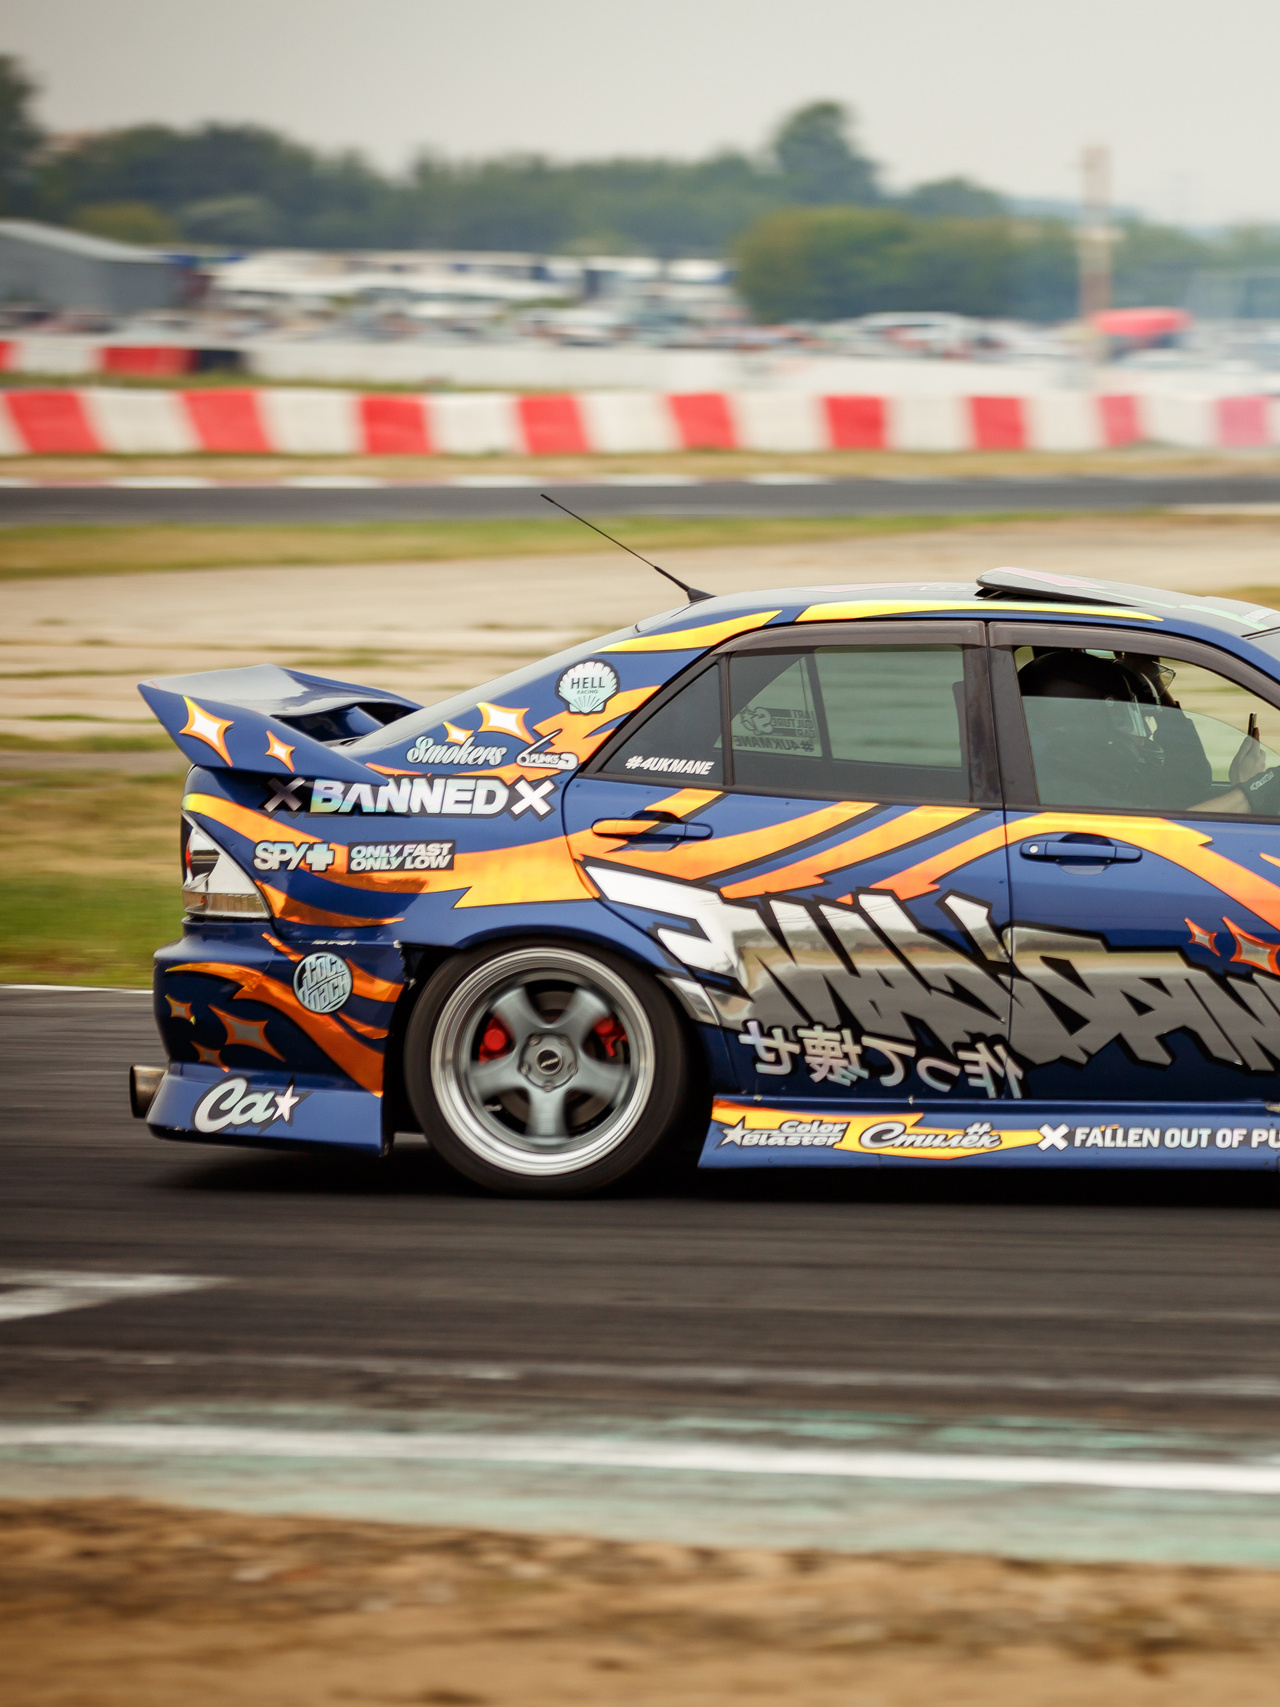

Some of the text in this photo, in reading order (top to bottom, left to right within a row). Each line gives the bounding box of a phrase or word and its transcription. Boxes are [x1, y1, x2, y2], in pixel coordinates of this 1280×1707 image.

[570, 677, 606, 690] HELL
[406, 735, 508, 766] Smokers
[530, 753, 561, 764] PUNKS
[624, 755, 715, 775] #4UKMANE
[310, 777, 510, 815] BANNED
[254, 841, 309, 871] SPY
[350, 842, 453, 859] ONLY FAST
[350, 855, 452, 871] ONLY LOW
[778, 1120, 849, 1135] Color
[741, 1133, 844, 1147] Blaster
[1073, 1126, 1161, 1149] FALLEN
[1164, 1127, 1211, 1149] OUT
[1214, 1127, 1247, 1149] OF
